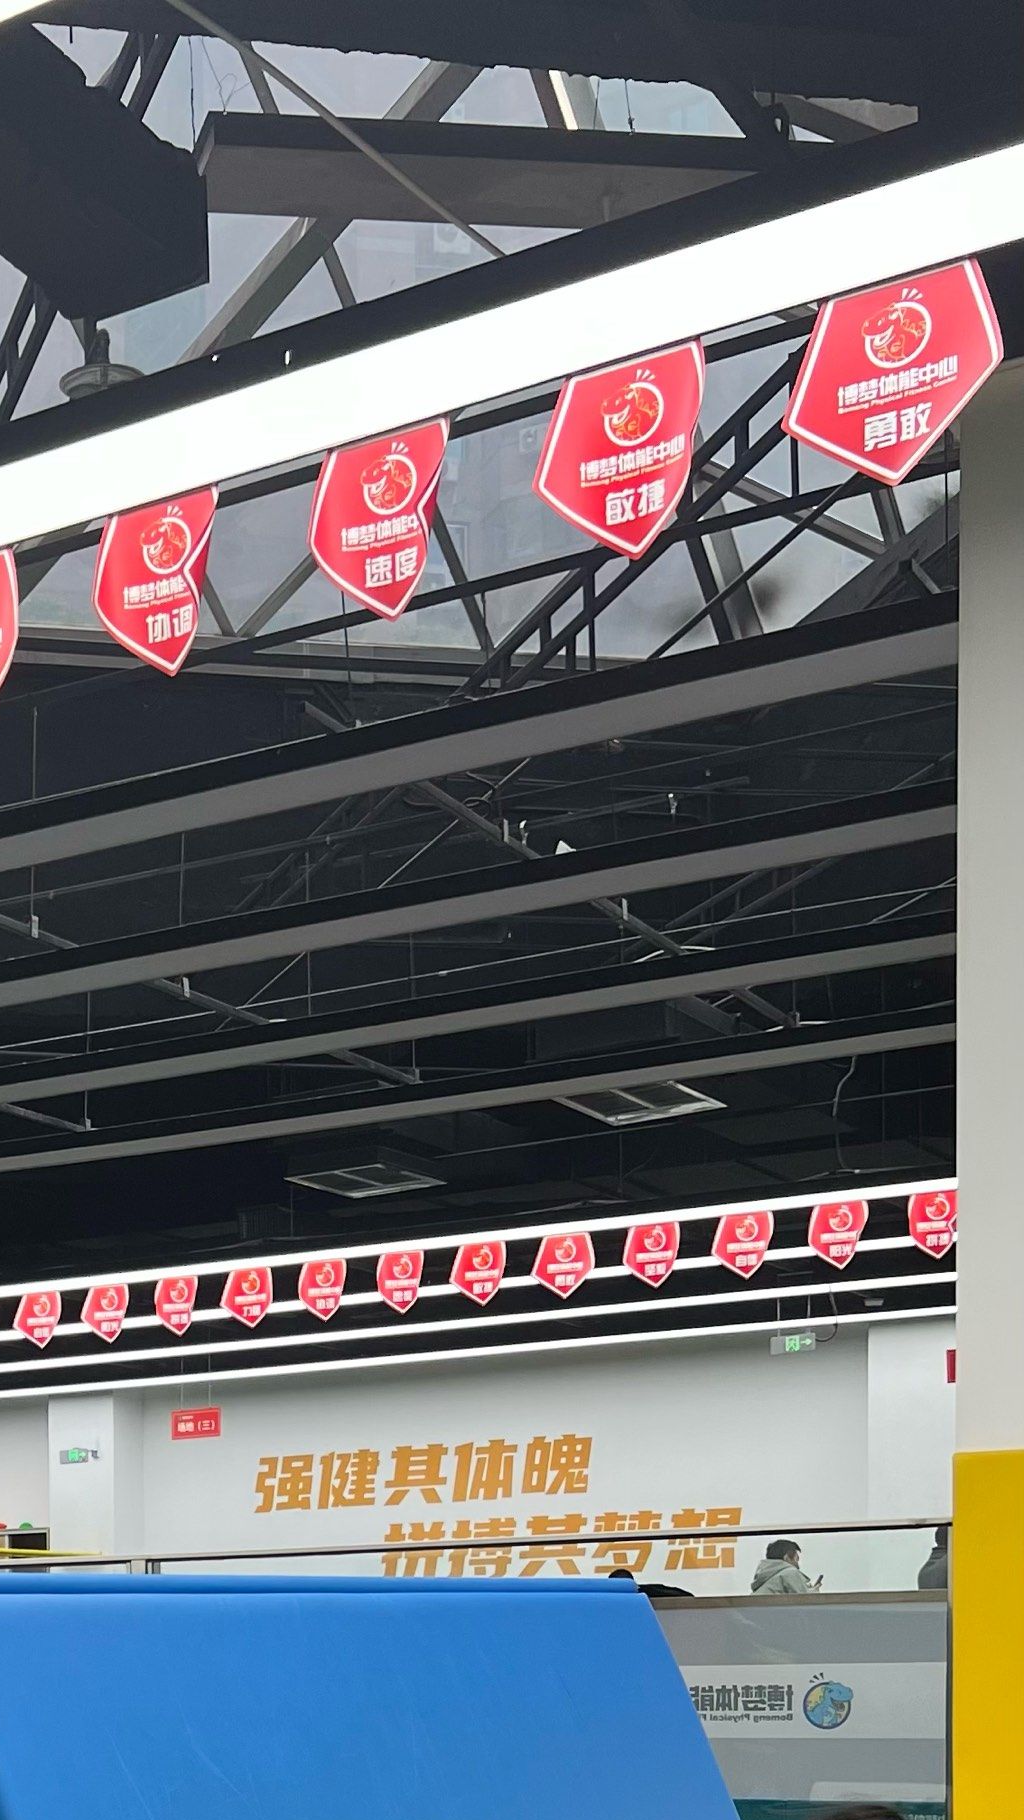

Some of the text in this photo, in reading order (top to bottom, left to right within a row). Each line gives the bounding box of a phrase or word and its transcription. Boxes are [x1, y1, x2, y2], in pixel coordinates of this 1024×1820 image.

[837, 354, 958, 407] 博梦体能中心
[863, 401, 933, 452] 勇敢
[580, 433, 685, 480] 博梦体能中心
[605, 478, 666, 526] 敏捷
[123, 574, 188, 604] 博梦体能
[365, 546, 419, 588] 速度
[146, 603, 194, 644] 协调
[255, 1434, 593, 1513] 强健其体魄
[381, 1506, 742, 1578] 拼搏其梦想
